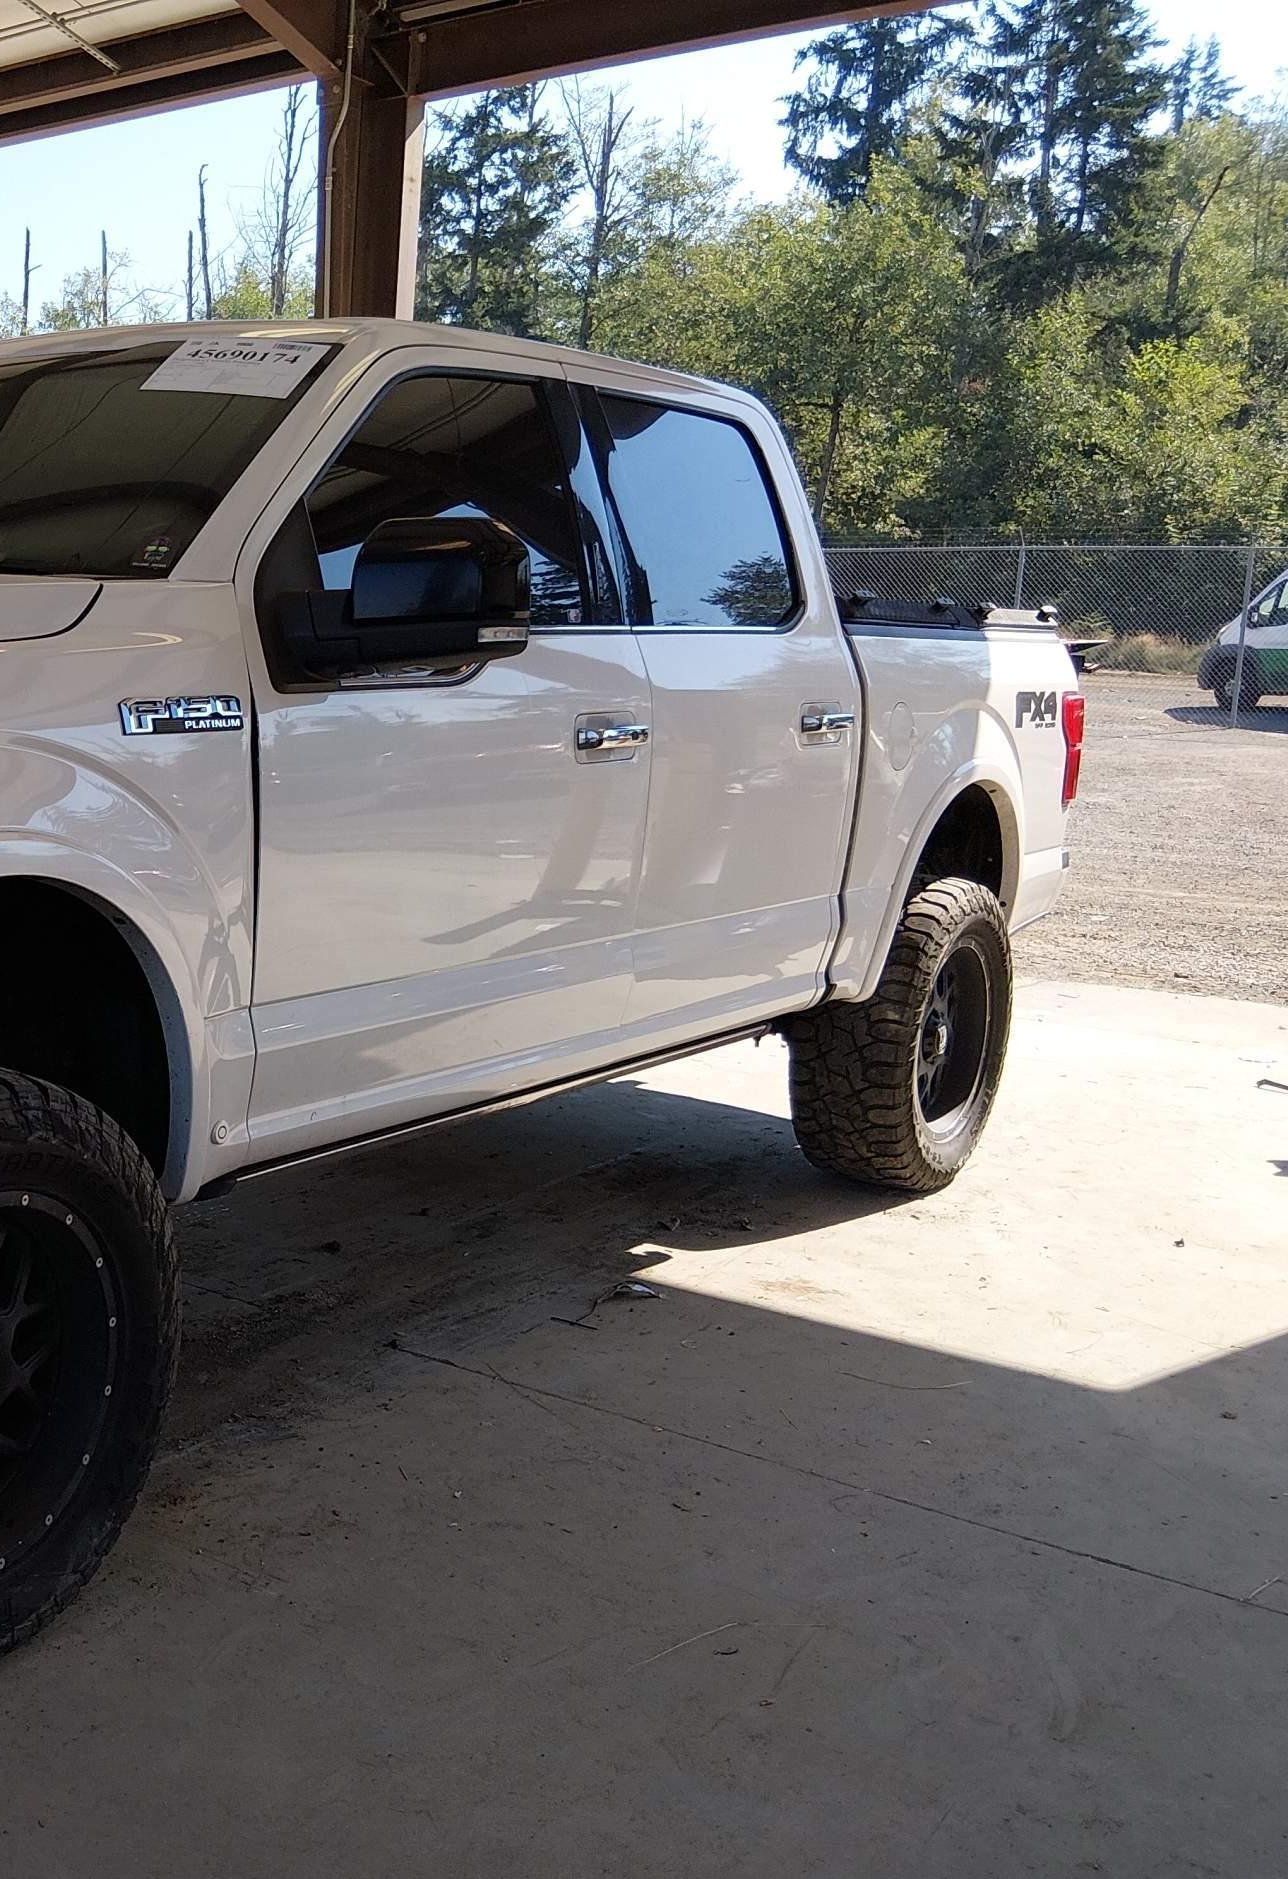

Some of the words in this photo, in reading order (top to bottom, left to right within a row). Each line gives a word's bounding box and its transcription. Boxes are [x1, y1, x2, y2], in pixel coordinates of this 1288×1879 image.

[187, 348, 301, 365] 45690174
[1015, 691, 1057, 728] FX4
[185, 719, 241, 729] PLATINUM
